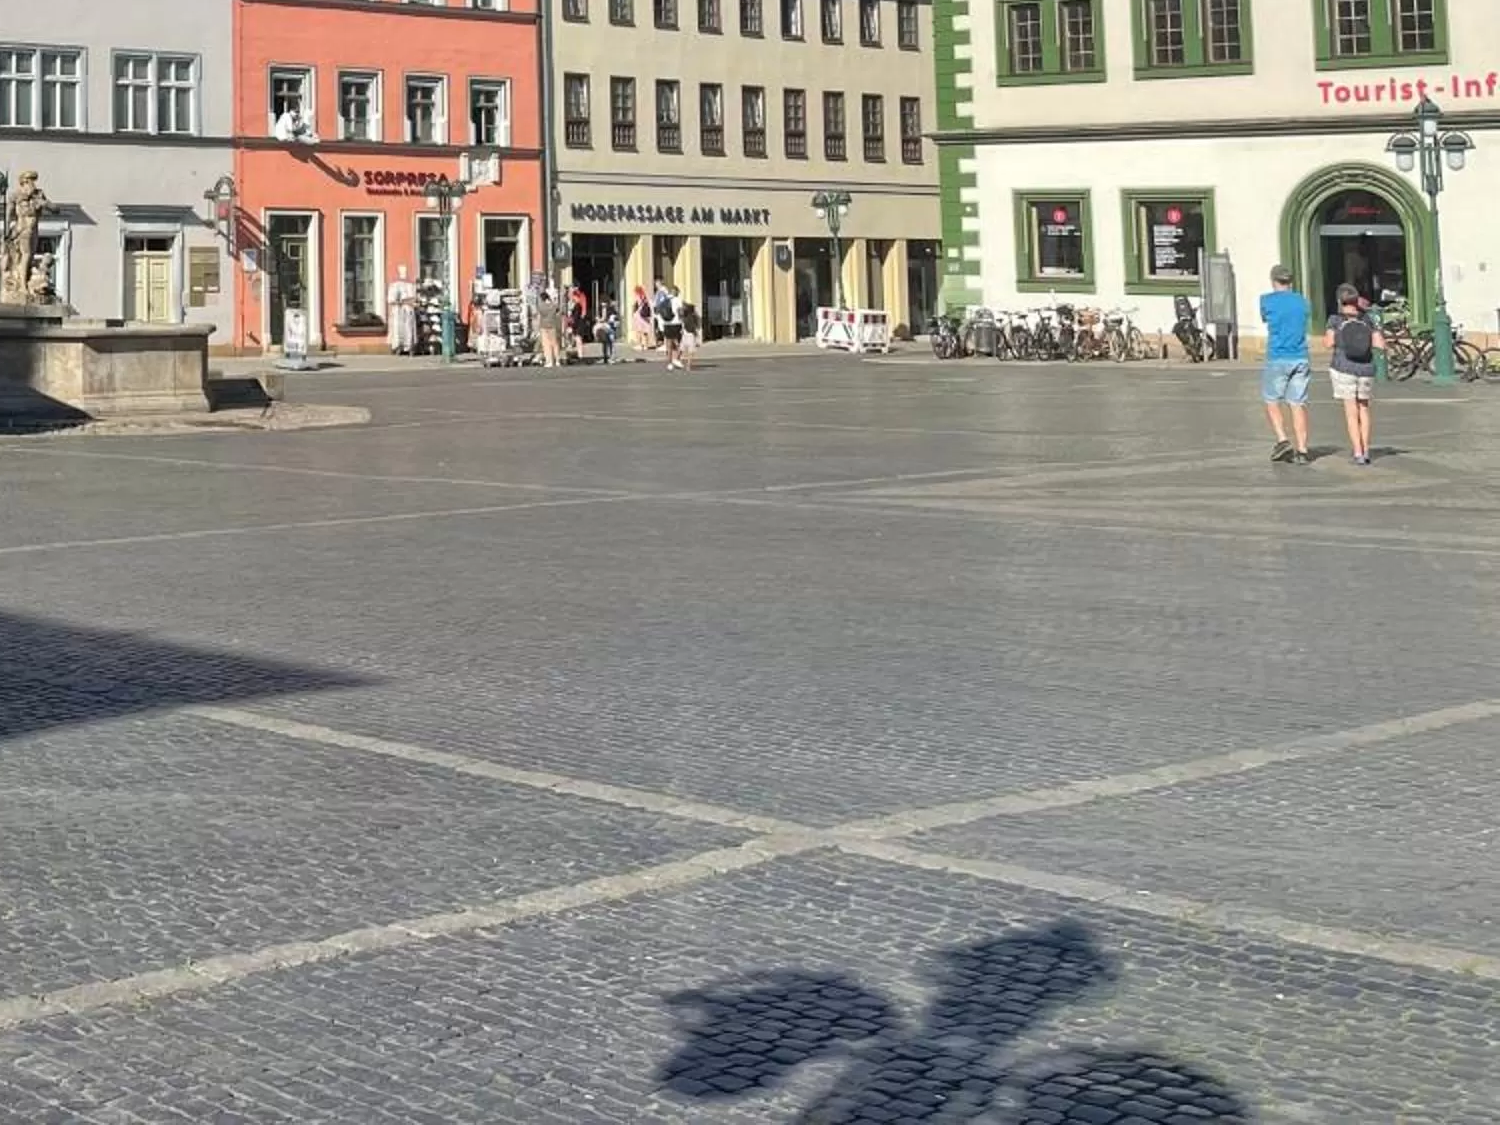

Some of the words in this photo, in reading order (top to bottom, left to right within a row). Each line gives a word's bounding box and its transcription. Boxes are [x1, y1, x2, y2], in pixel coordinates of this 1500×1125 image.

[570, 202, 685, 224] MODEPASSAGE
[690, 206, 715, 224] AM
[720, 207, 770, 225] MARKT
